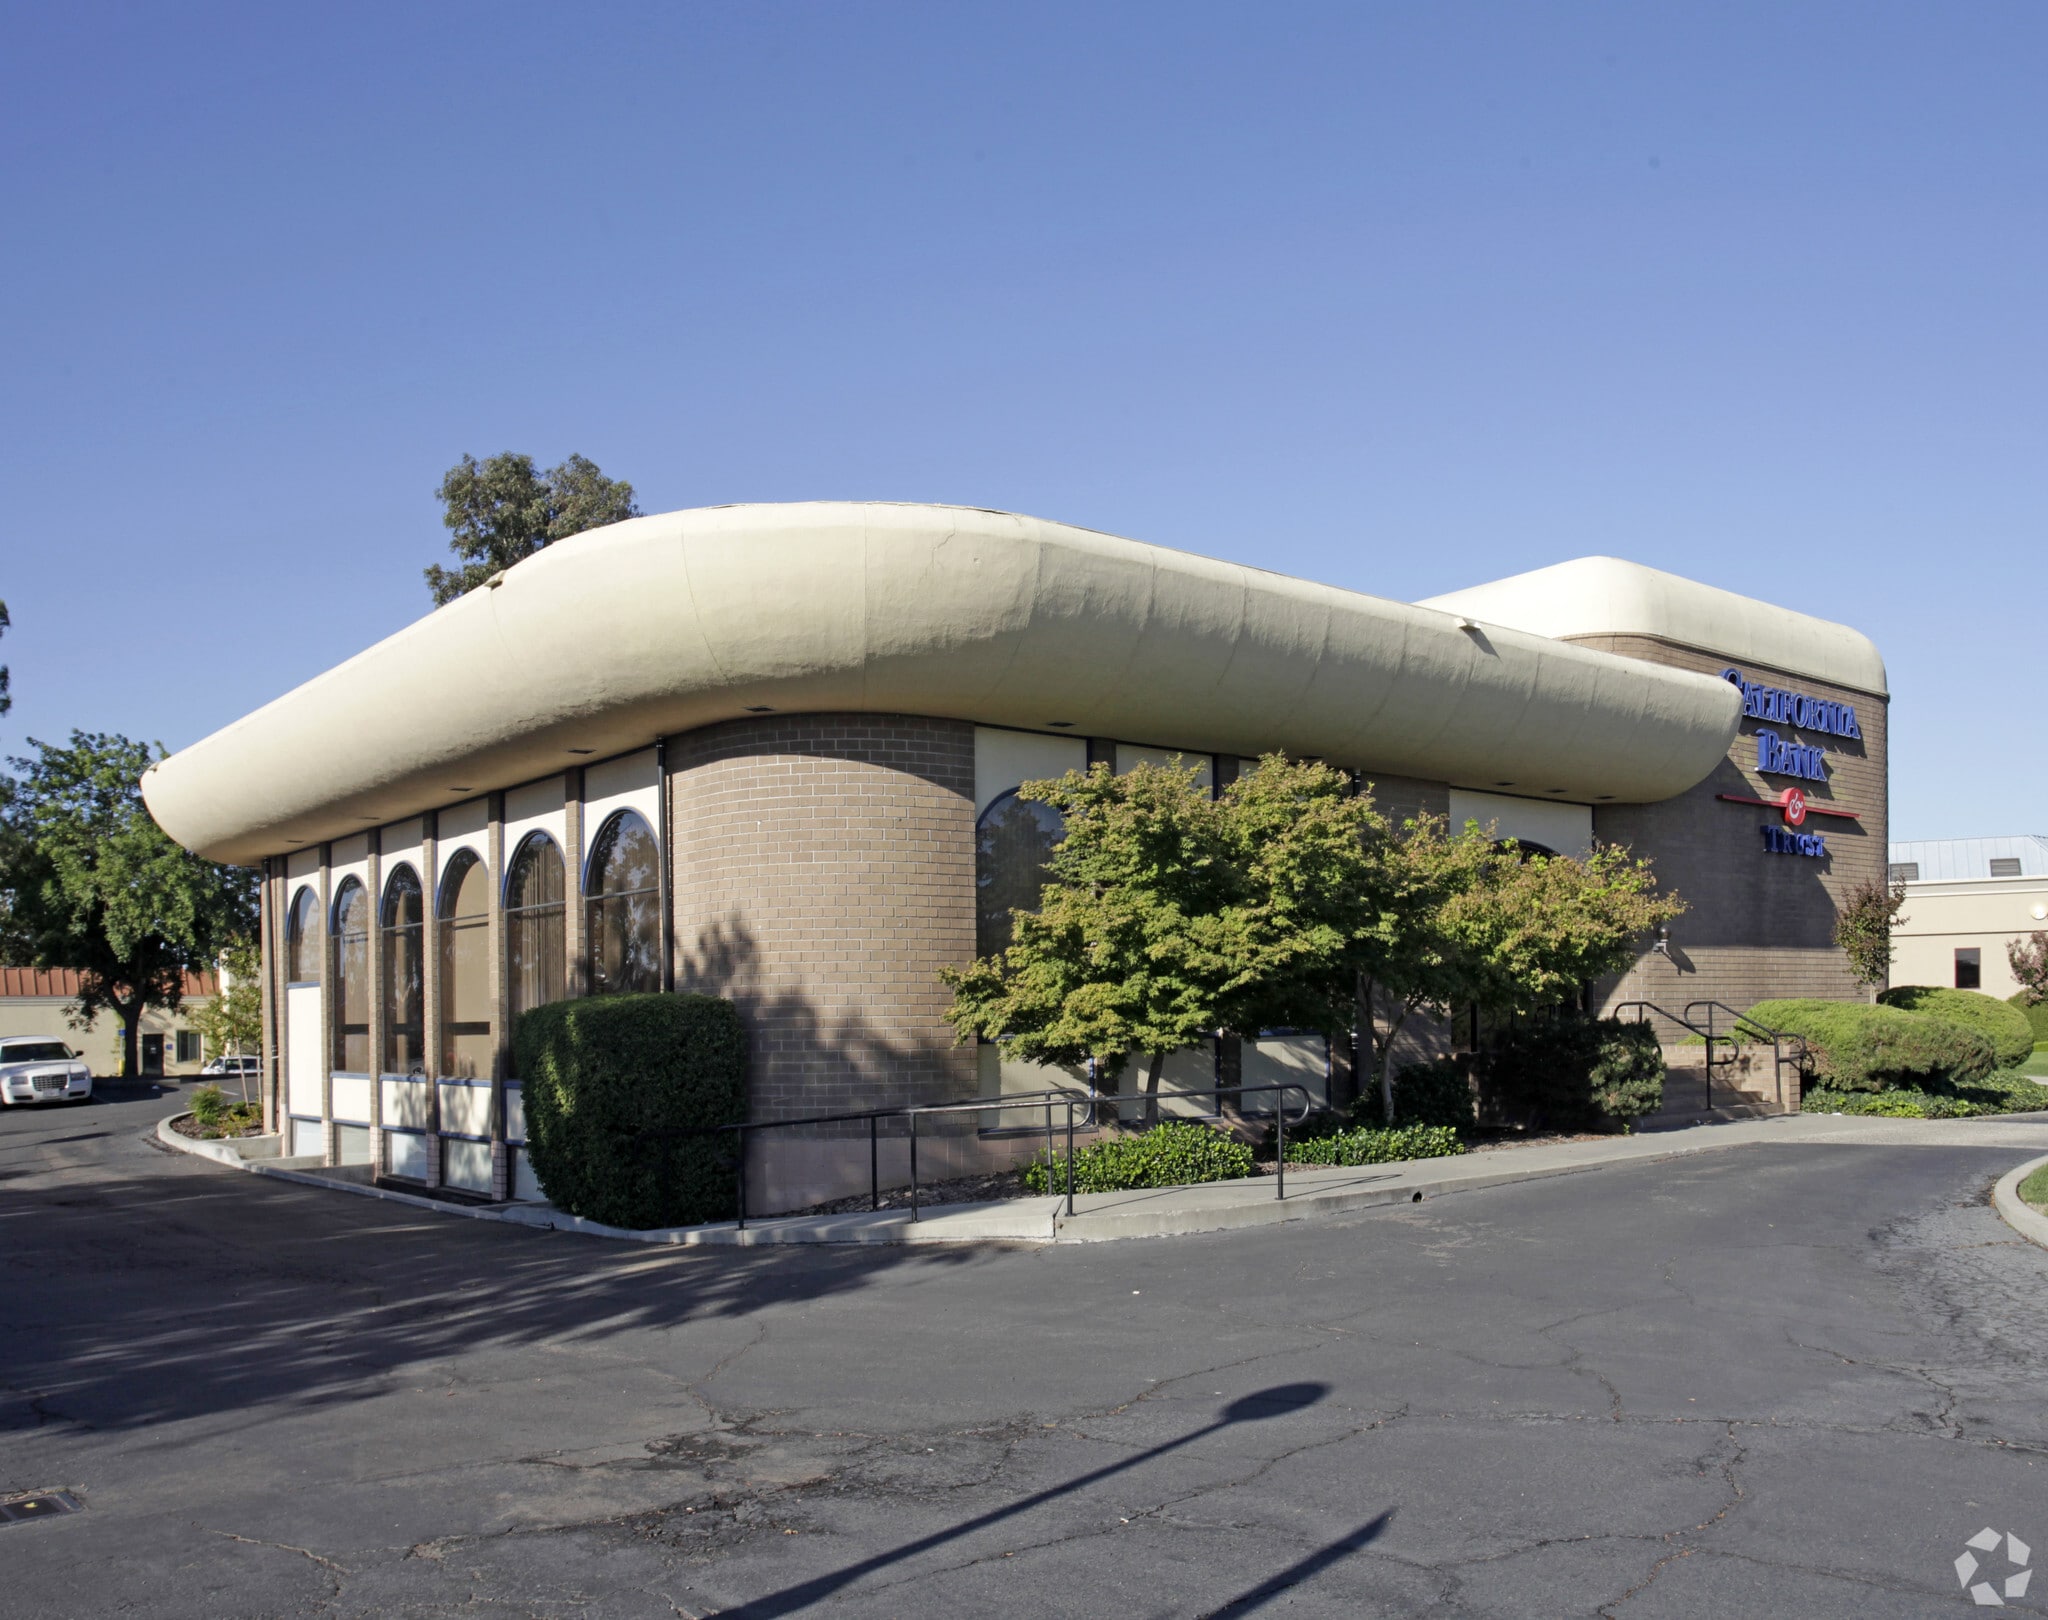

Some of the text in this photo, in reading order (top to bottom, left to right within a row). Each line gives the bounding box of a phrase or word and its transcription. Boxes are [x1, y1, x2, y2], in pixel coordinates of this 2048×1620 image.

[1756, 728, 1827, 781] BANK
[1788, 792, 1804, 819] &
[1761, 824, 1824, 857] TRUST
